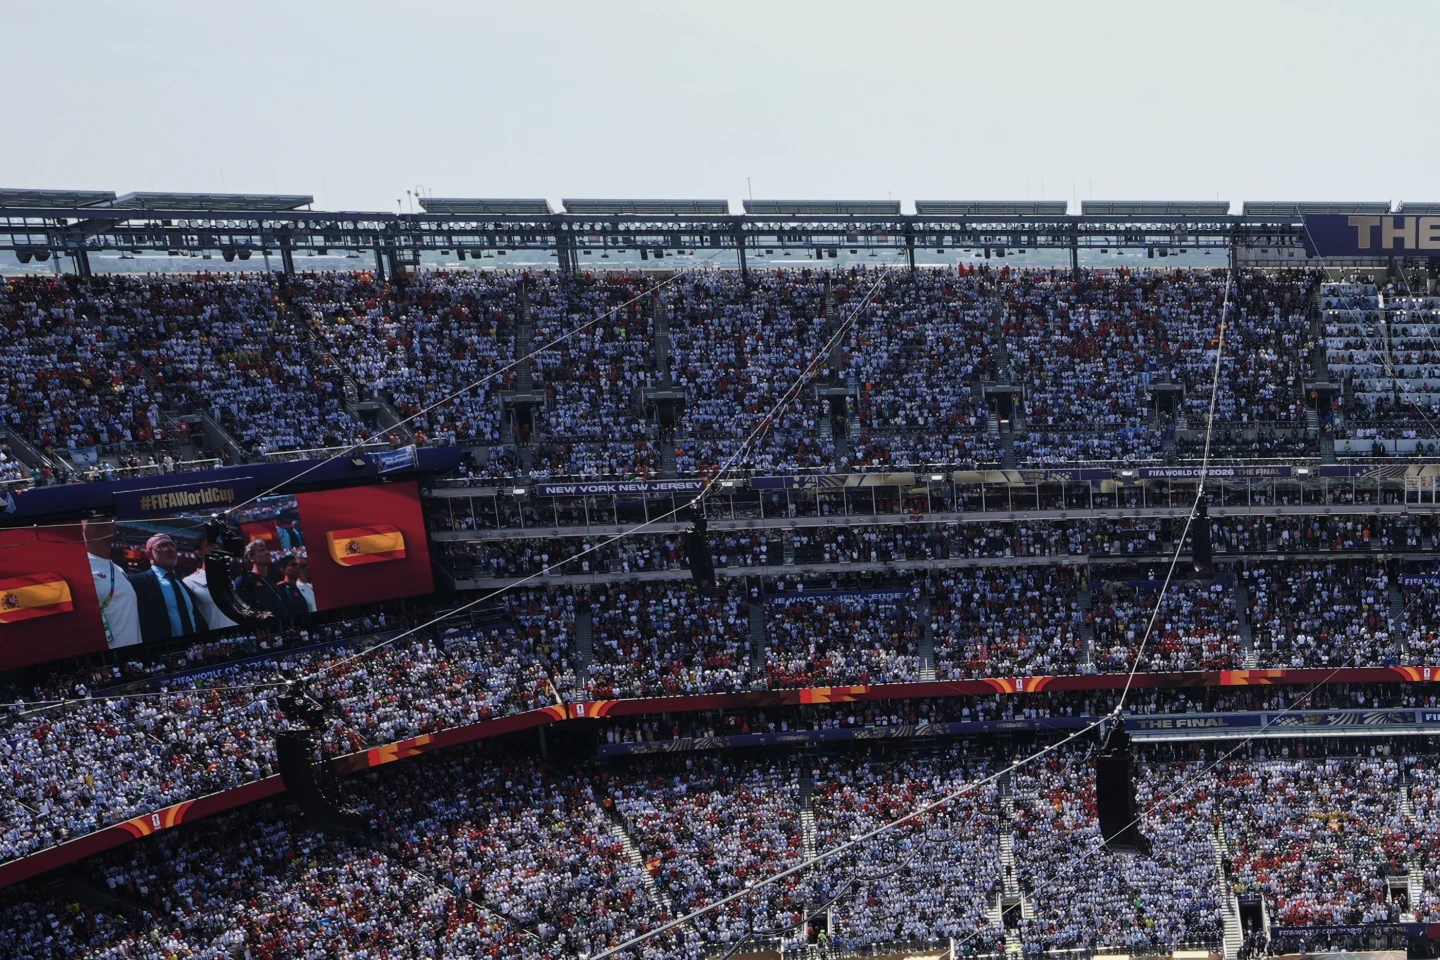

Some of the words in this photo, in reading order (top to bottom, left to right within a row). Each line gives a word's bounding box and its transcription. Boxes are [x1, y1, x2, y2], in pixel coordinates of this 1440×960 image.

[546, 486, 576, 494] NEW
[579, 485, 617, 493] YORK
[619, 483, 648, 492] NEW
[651, 482, 703, 491] JERSEY
[139, 487, 235, 511] #FIFAWorldCup
[1137, 719, 1173, 729] THE
[1176, 718, 1229, 729] FINAL
